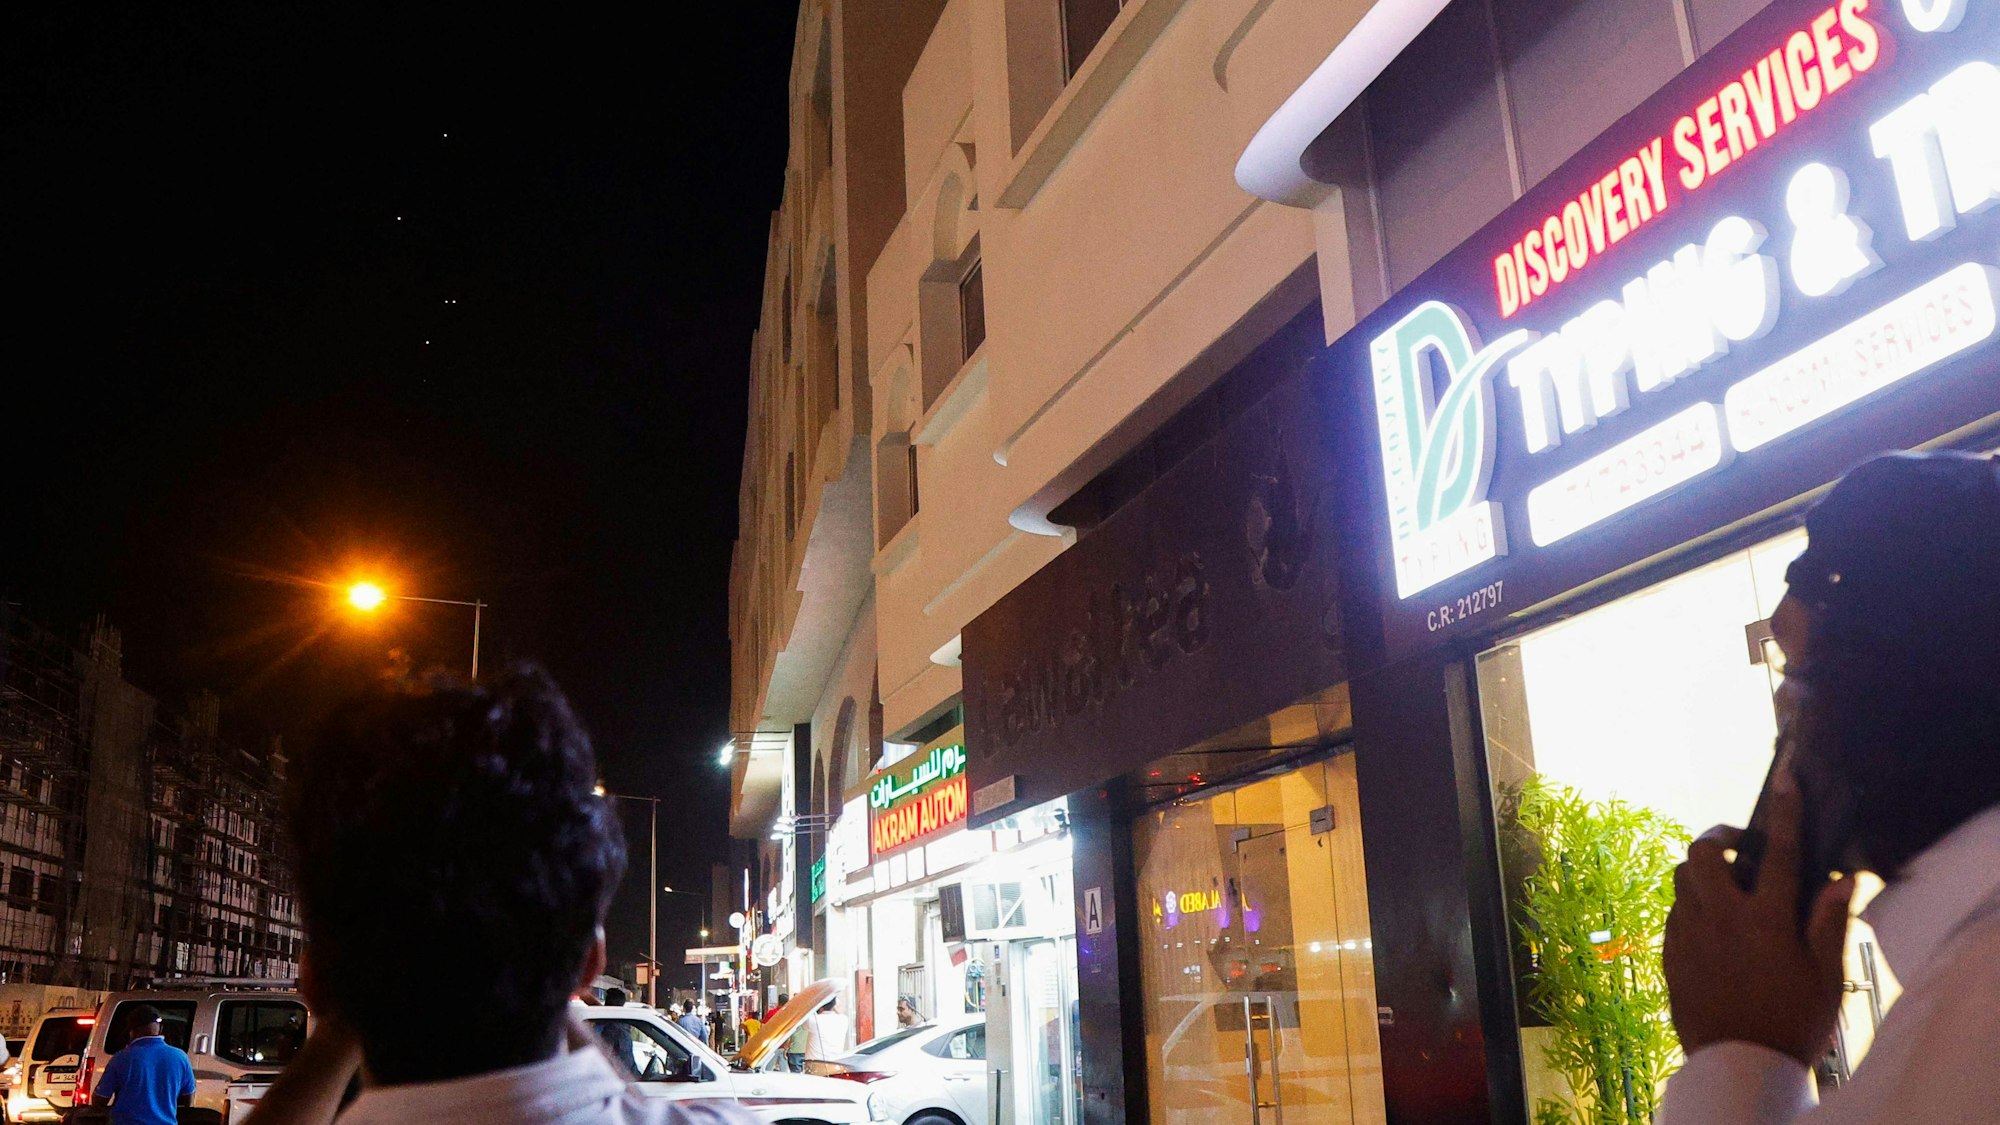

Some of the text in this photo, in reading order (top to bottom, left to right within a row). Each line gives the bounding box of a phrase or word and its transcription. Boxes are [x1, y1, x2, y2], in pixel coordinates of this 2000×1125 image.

[1495, 0, 1879, 320] DISCOVERY SERVICES
[1508, 216, 1770, 454] TYPING
[1785, 162, 1872, 297] &
[1427, 580, 1504, 632] C.R: 212797
[870, 747, 942, 809] للسيارات
[874, 778, 968, 854] AKRAM AUTOM
[1089, 892, 1100, 930] A
